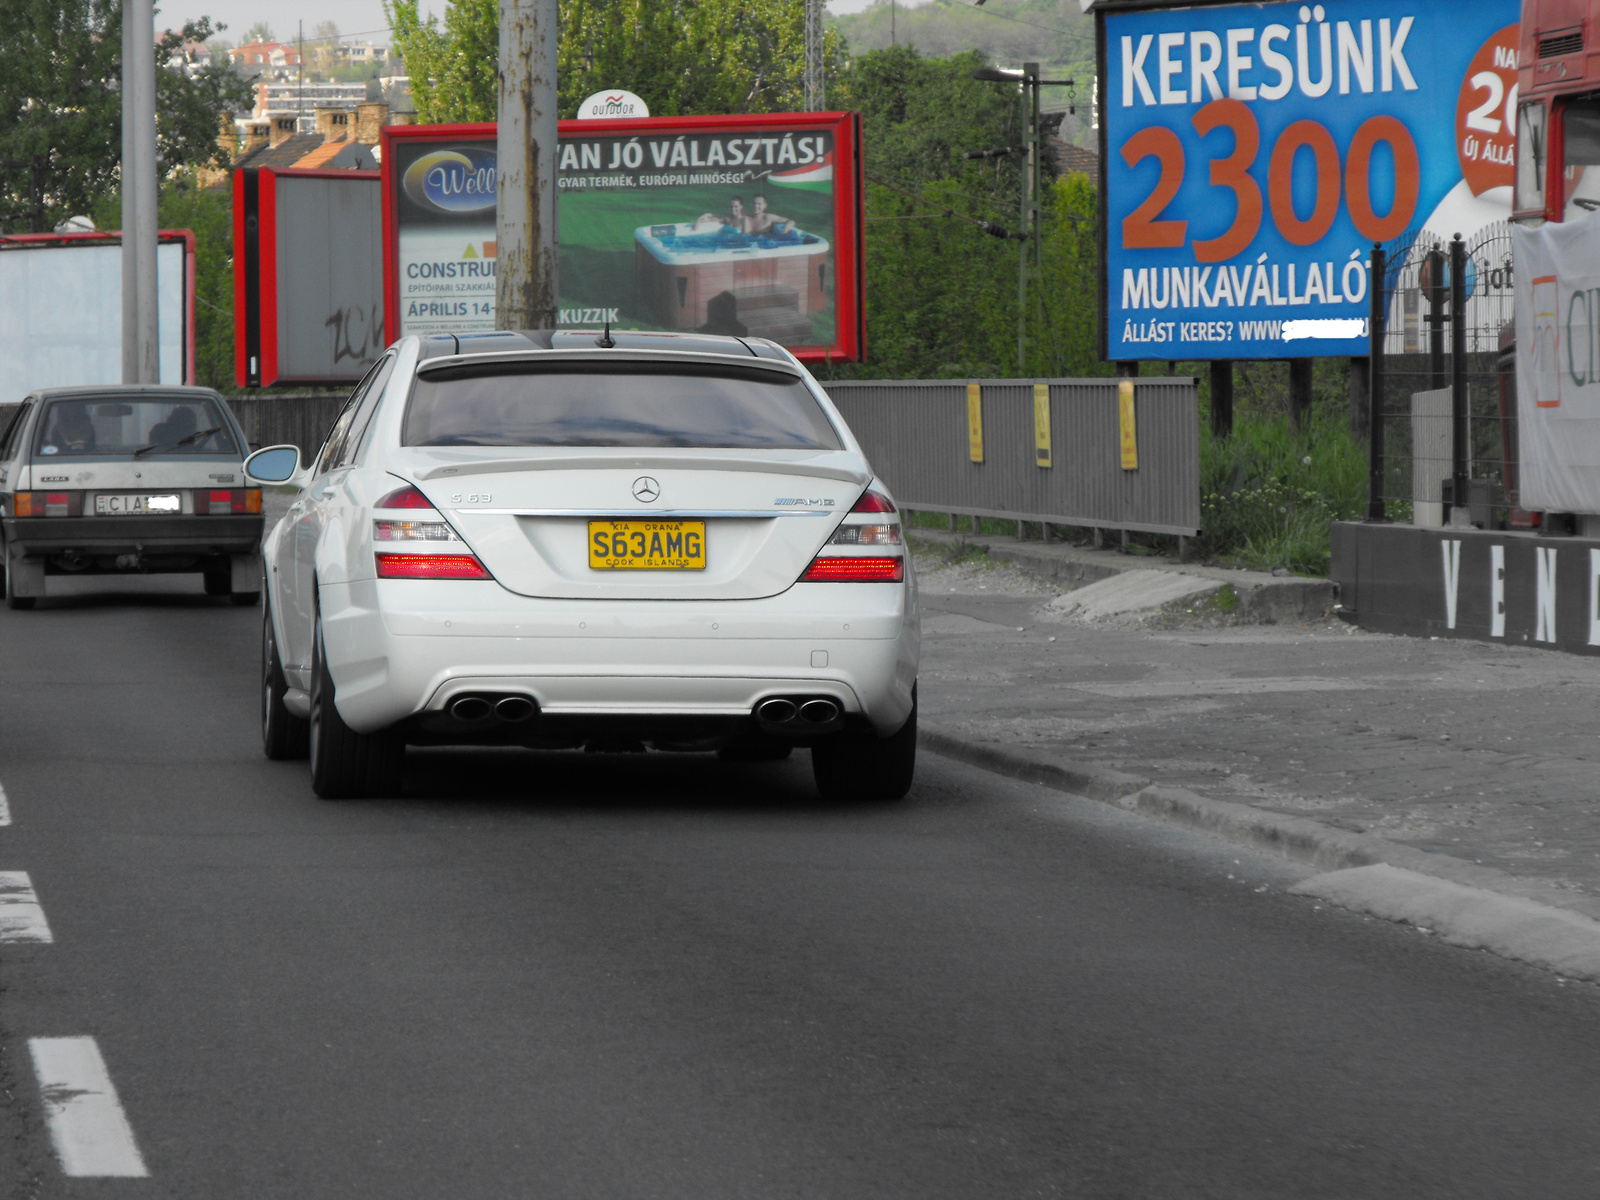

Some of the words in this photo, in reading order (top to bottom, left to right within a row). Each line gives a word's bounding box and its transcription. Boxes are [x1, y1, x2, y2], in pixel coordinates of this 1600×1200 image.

[1120, 4, 1419, 107] KERESÜNK
[1494, 45, 1520, 70] NA
[592, 103, 635, 116] OUTDOOR
[557, 143, 601, 170] AN
[608, 136, 643, 169] JÓ
[649, 132, 825, 168] VÁLASZTÁS!
[1463, 134, 1480, 161] ÚJ
[588, 174, 637, 188] TERMÉK,
[639, 173, 687, 186] EURÓPAI
[1120, 97, 1420, 263] 2300
[407, 300, 468, 317] ÁPRILIS
[556, 307, 619, 324] KUZZIK
[1122, 318, 1175, 343] ÁLLÁST
[1180, 320, 1234, 342] KERES?
[1567, 287, 1600, 388] CI
[451, 493, 462, 503] S
[467, 493, 492, 503] 63
[612, 523, 630, 531] KIA
[644, 523, 681, 531] ORANA
[593, 531, 701, 558] S63AMG
[605, 558, 634, 566] COOK
[643, 558, 690, 566] ISLANDS
